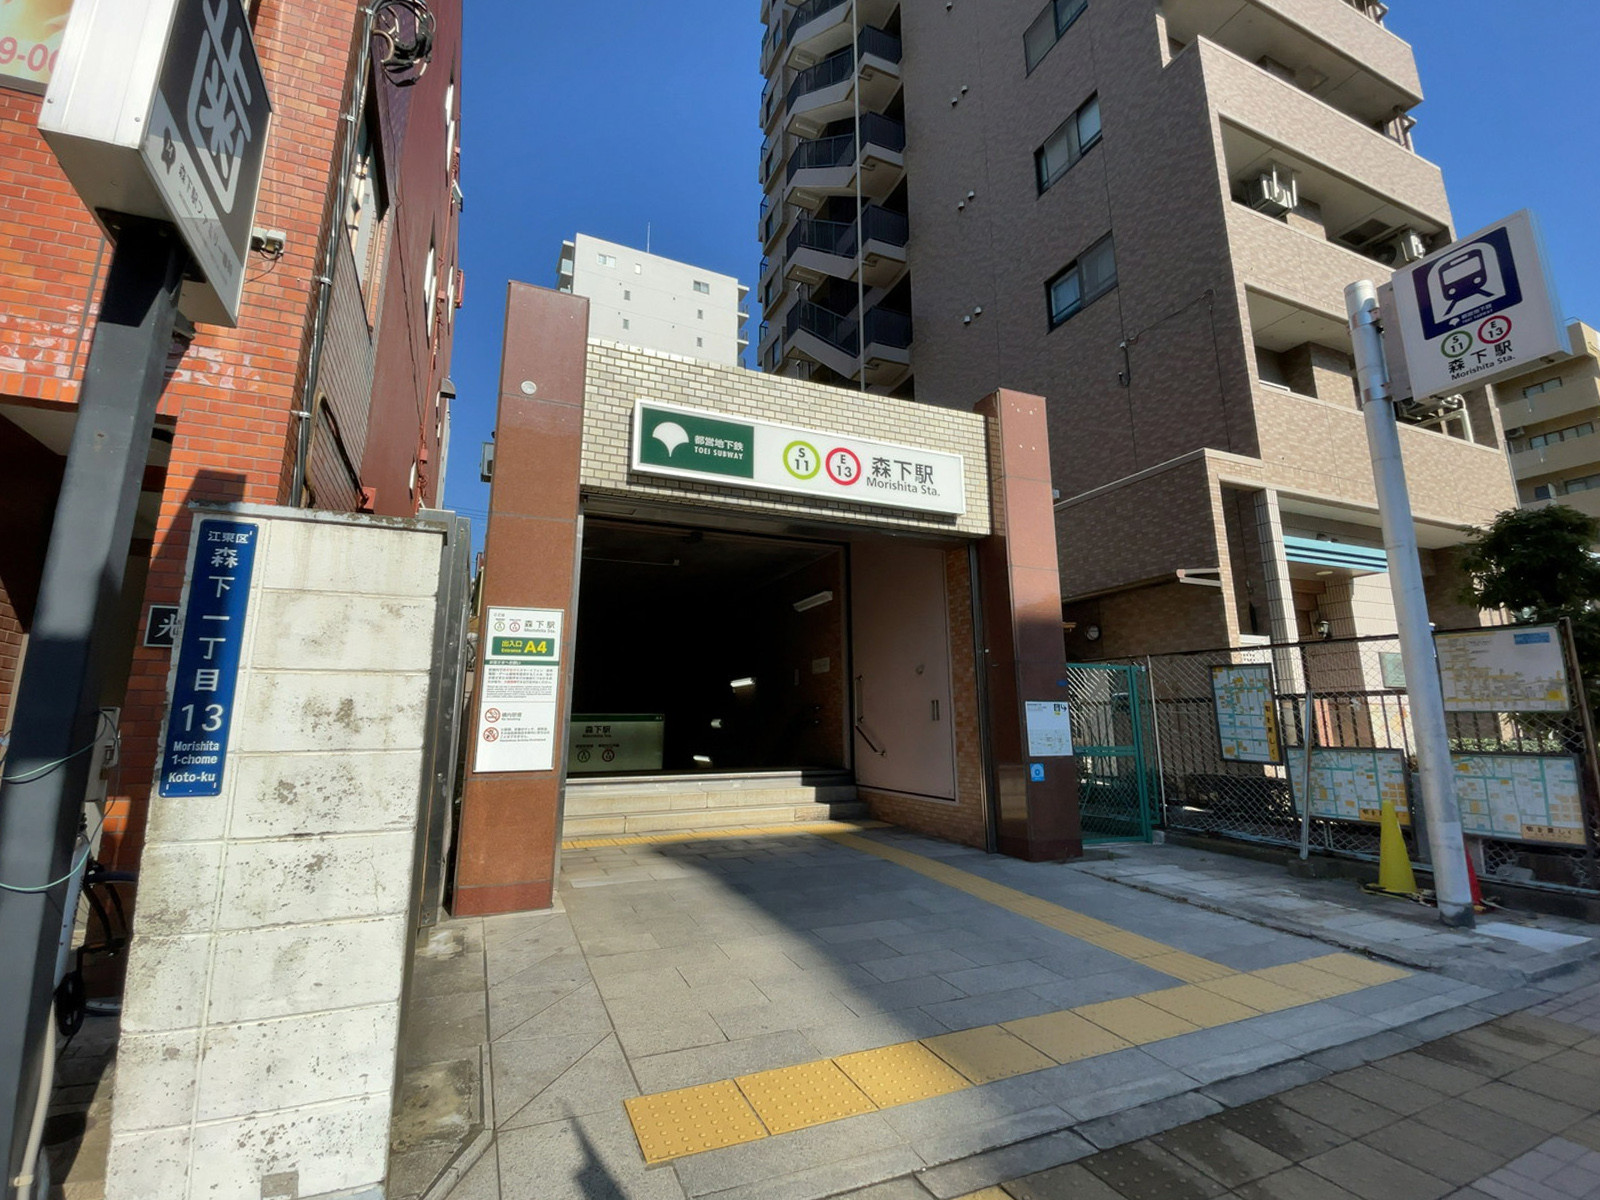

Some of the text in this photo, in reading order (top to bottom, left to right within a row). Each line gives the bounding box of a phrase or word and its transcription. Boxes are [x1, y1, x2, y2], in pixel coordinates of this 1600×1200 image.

[1490, 320, 1497, 328] E
[1452, 335, 1459, 343] S
[1488, 327, 1504, 338] 13
[1450, 342, 1463, 353] 11
[1448, 339, 1513, 374] 森下駅
[1451, 354, 1516, 380] Morishita Sta.
[694, 434, 744, 451] 都営地下鉄
[694, 446, 743, 460] TOEI SUBWAY
[798, 447, 806, 458] S
[794, 458, 809, 471] 11
[840, 454, 846, 465] E
[836, 465, 853, 478] 13
[871, 456, 935, 486] 森下駅
[866, 476, 941, 497] Morishita Sta.
[207, 530, 249, 545] 江東区
[194, 547, 239, 692] 森下一丁目
[501, 640, 523, 648] 出入口
[524, 640, 547, 654] A4
[181, 703, 224, 732] 13
[585, 725, 611, 734] 森下駅
[173, 741, 220, 752] Morishita
[171, 754, 218, 765] 1-chome
[168, 771, 216, 783] Koto-ku
